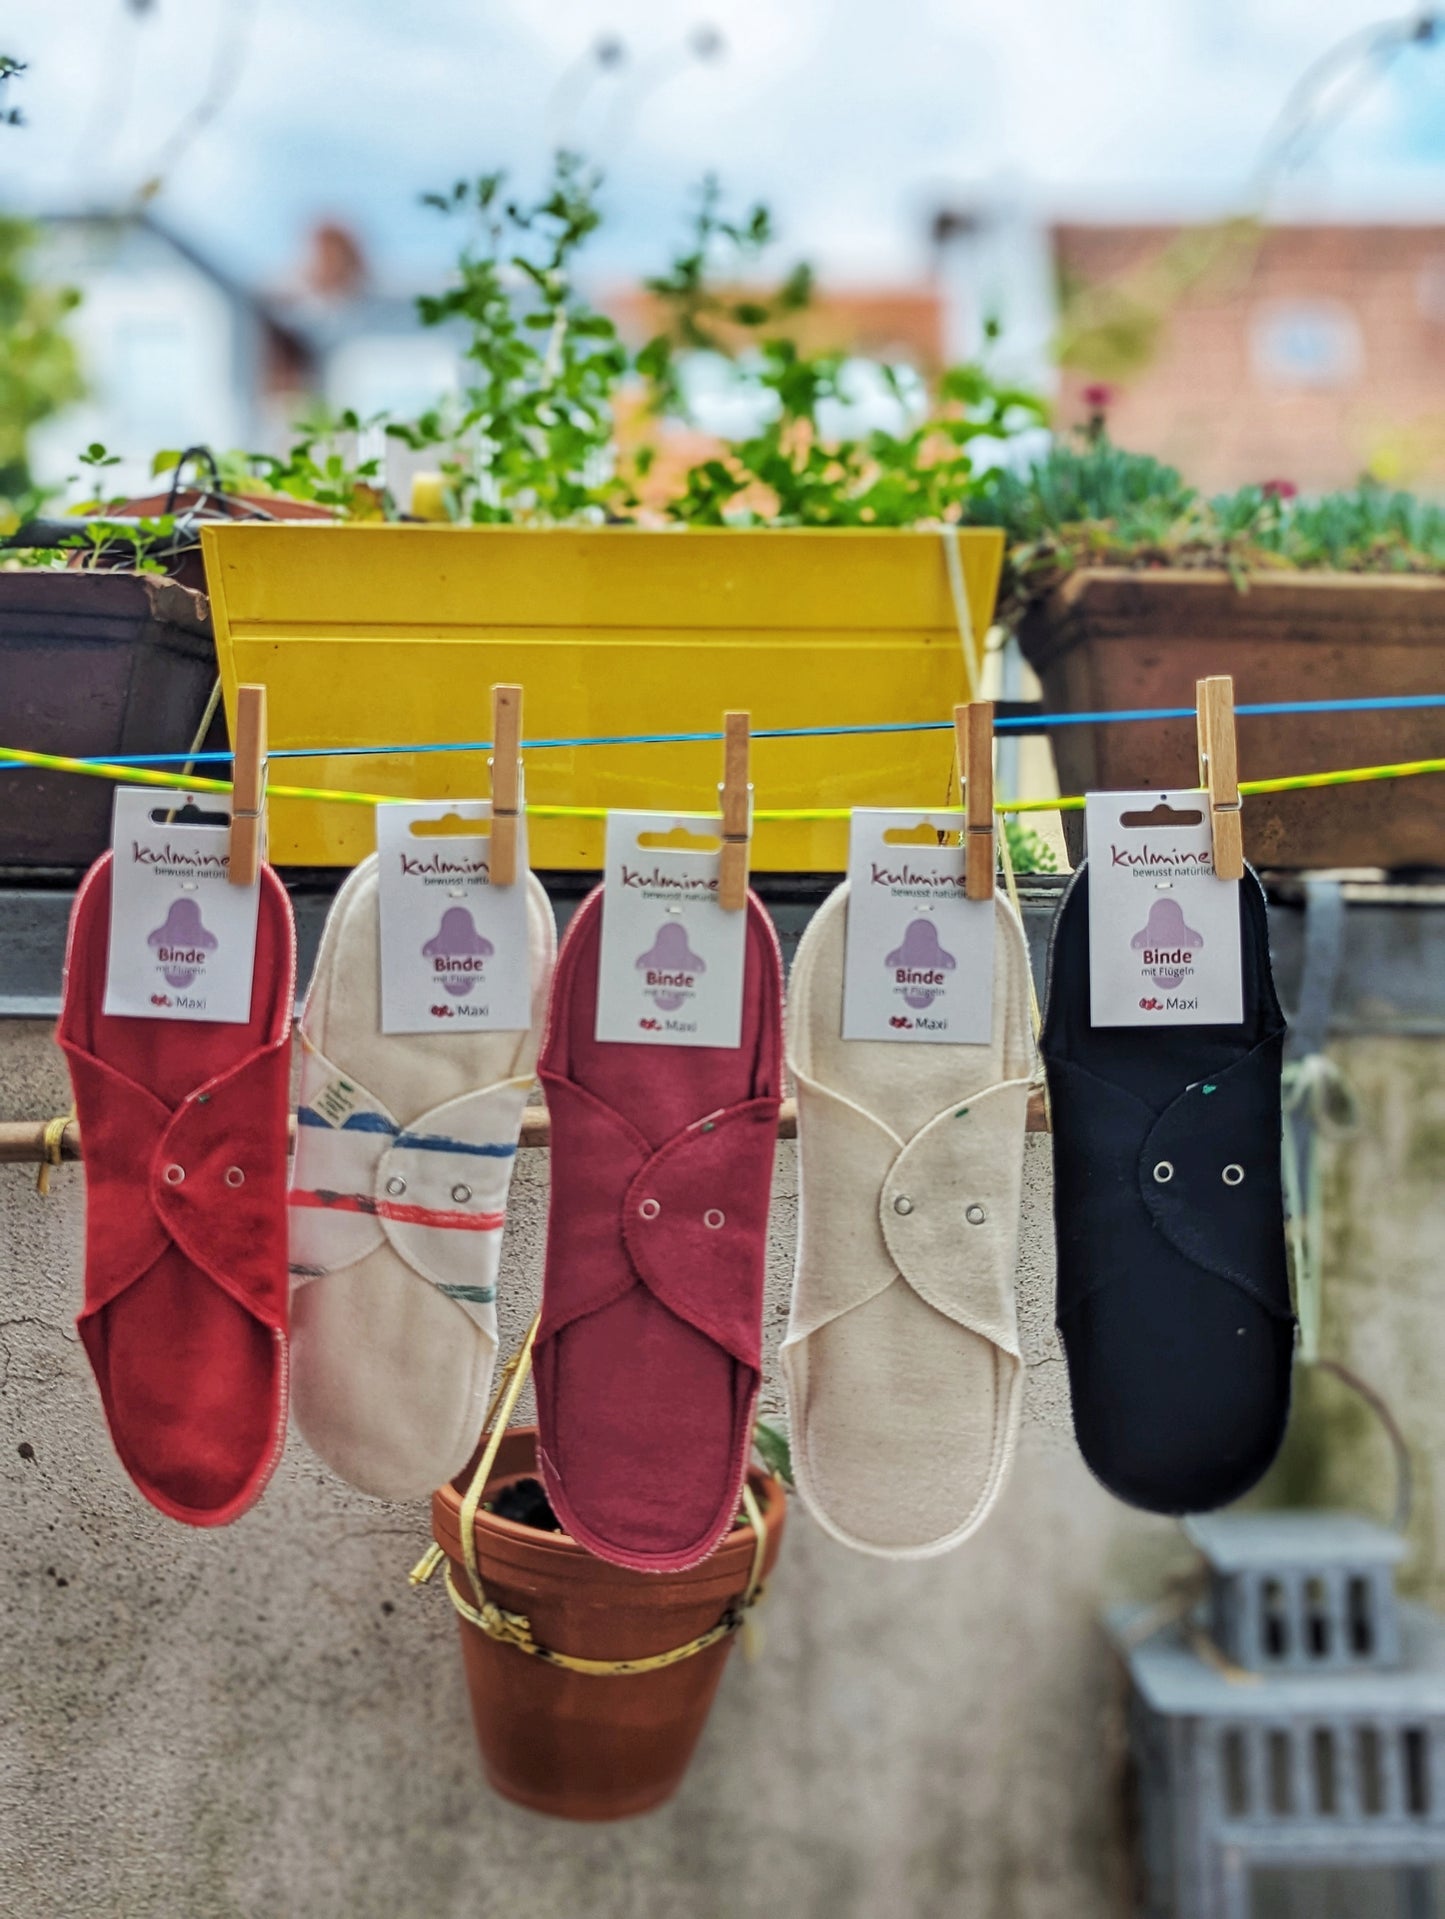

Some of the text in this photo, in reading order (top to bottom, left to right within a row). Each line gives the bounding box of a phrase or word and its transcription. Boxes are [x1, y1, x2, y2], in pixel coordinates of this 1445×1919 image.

[1110, 844, 1211, 867] kulmine
[401, 853, 489, 876] kulmin
[1132, 867, 1172, 877] bewusst
[622, 866, 720, 891] kulmine
[158, 947, 206, 964] Binde
[1143, 949, 1192, 965] Binde
[434, 957, 484, 972] Binde
[646, 971, 695, 989] Binde
[896, 969, 944, 985] Binde
[1141, 966, 1194, 979] mit Flügeln
[176, 998, 206, 1009] Maxi
[1166, 997, 1198, 1010] Maxi
[458, 1006, 489, 1017] Maxi
[665, 1020, 697, 1033] Maxi
[915, 1016, 947, 1030] Maxi
